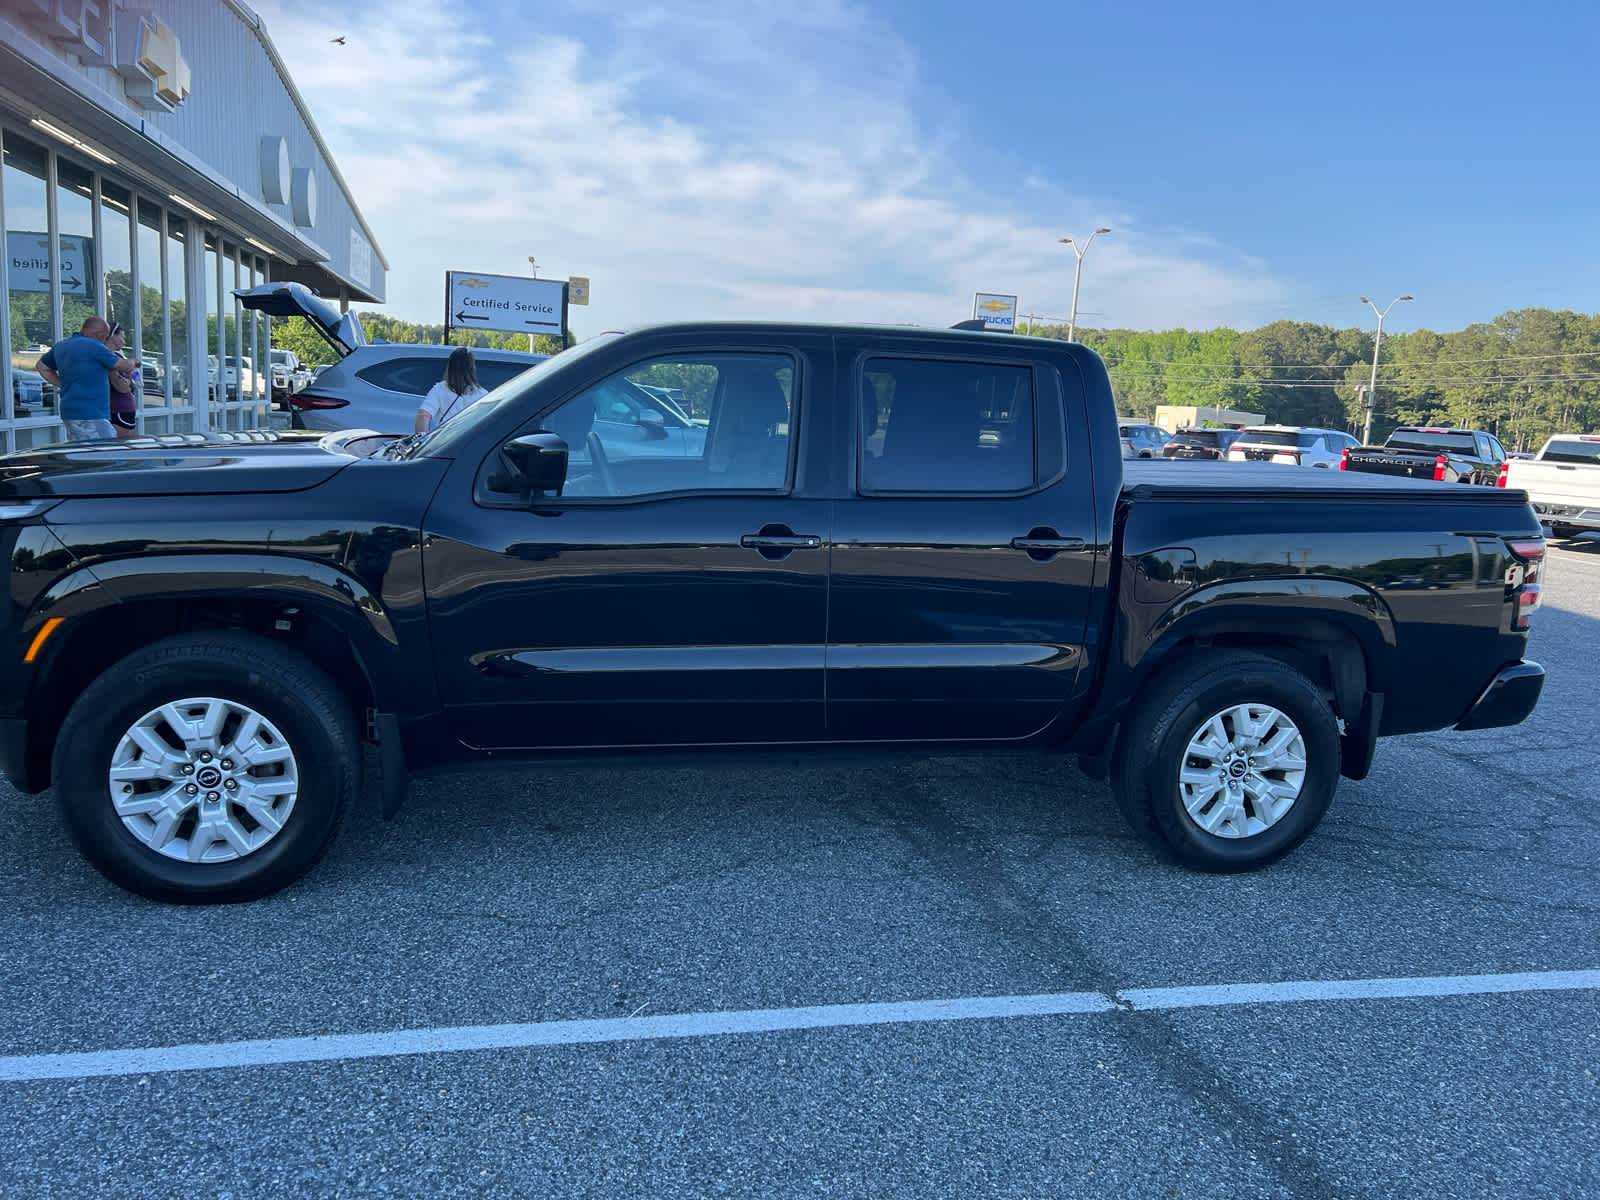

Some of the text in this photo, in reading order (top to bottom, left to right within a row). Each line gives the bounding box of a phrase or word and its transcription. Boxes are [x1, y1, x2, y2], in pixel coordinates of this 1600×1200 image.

[463, 297, 553, 314] Certified Service
[1352, 456, 1433, 467] CHEVROL
